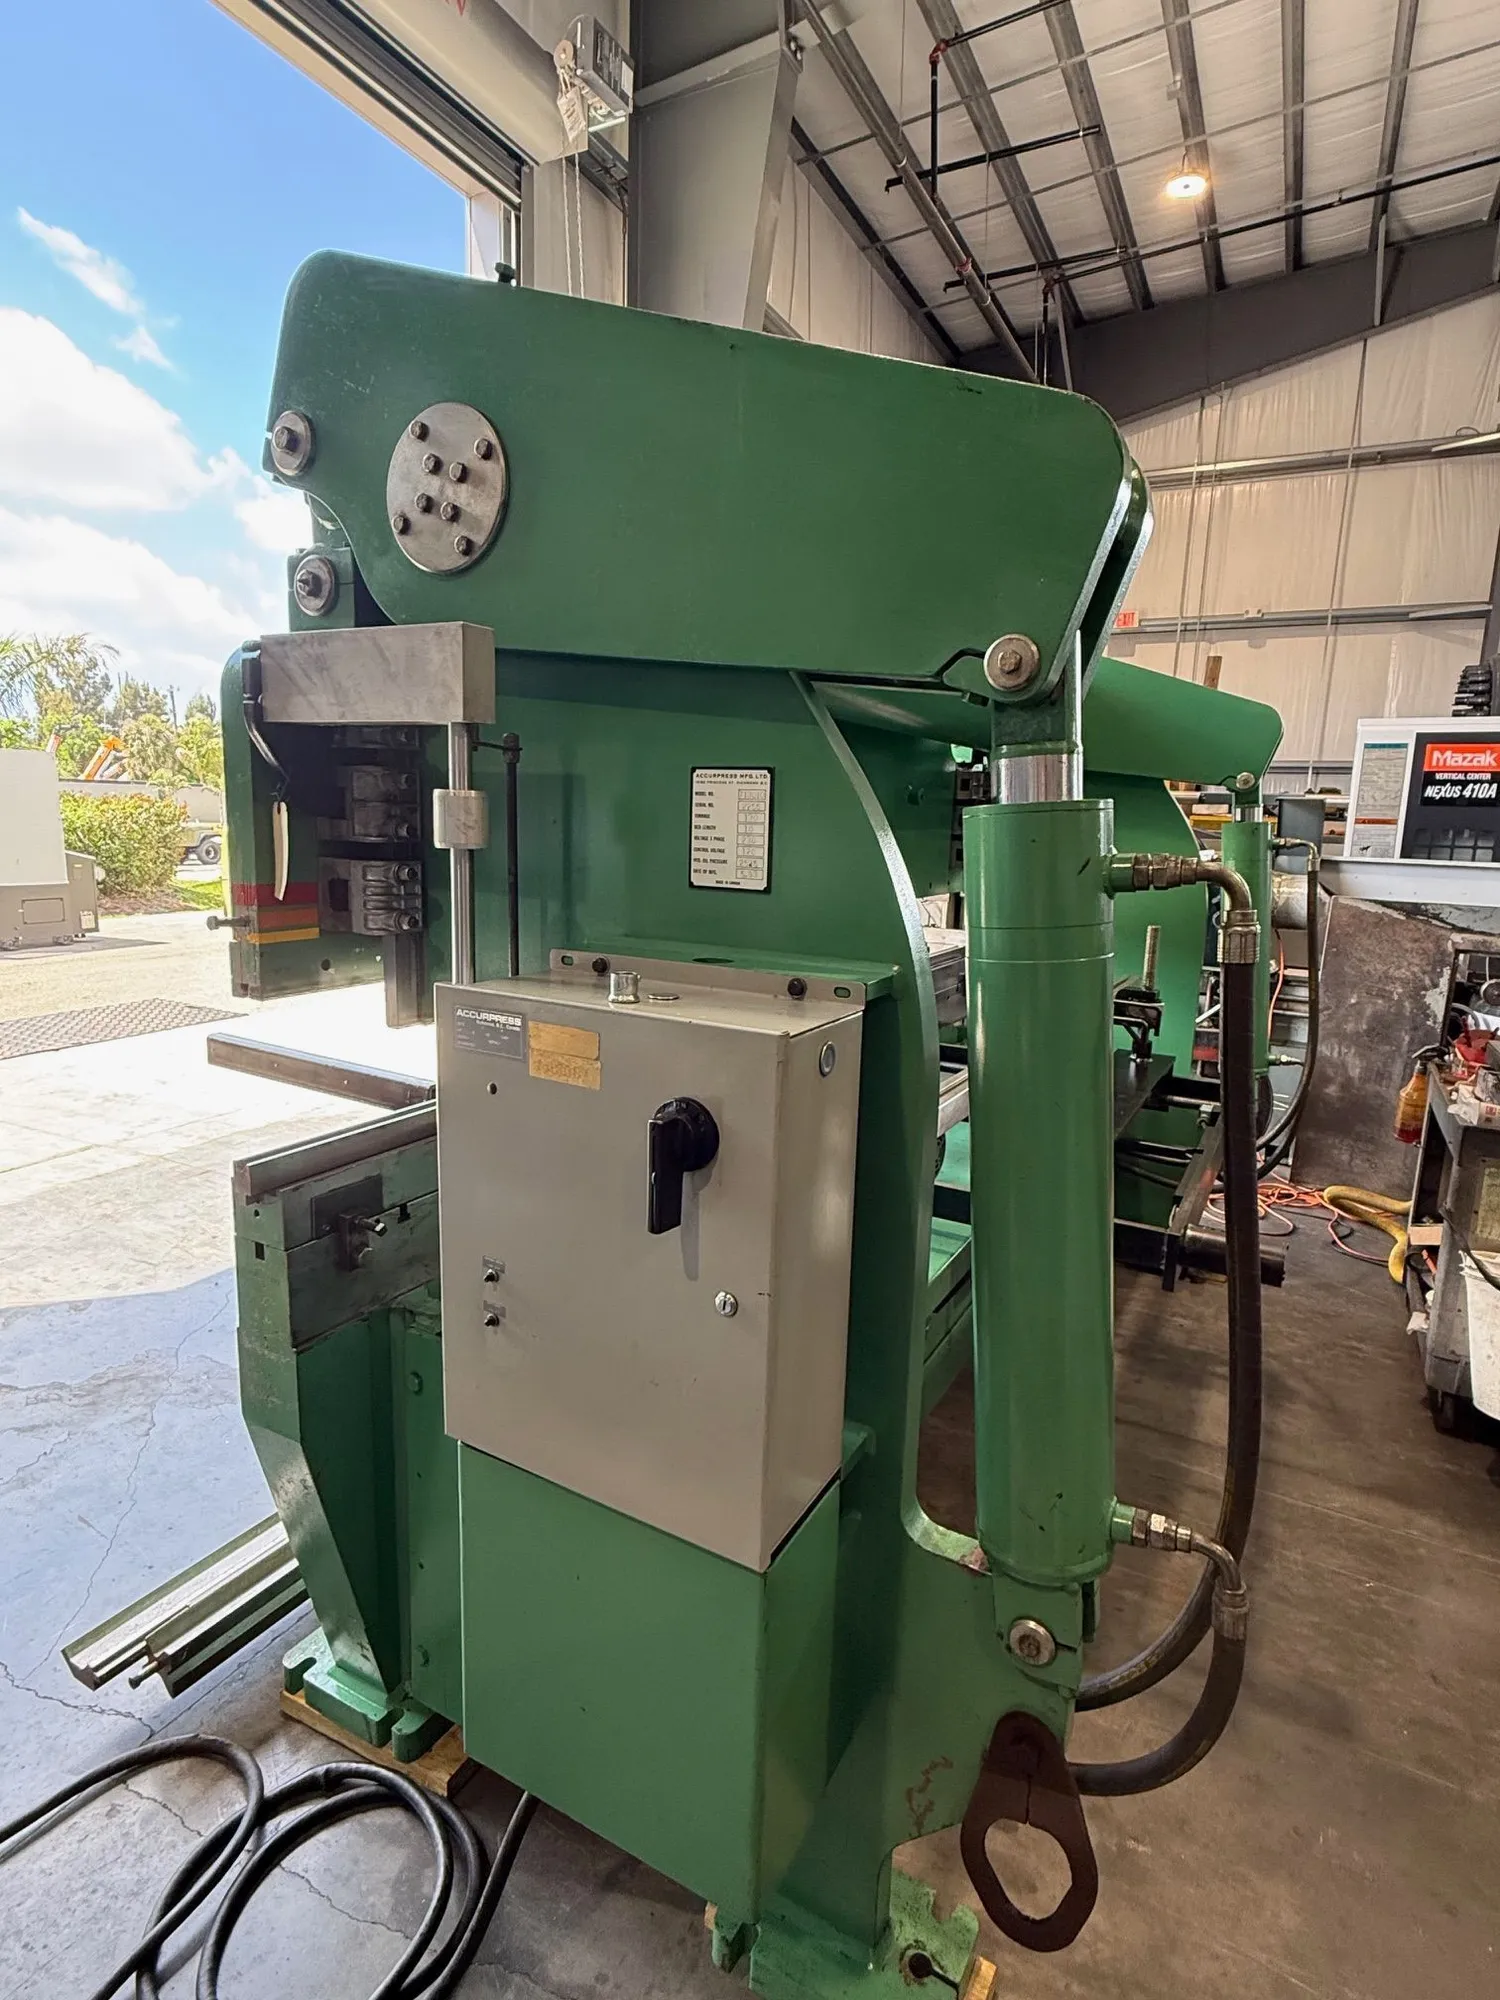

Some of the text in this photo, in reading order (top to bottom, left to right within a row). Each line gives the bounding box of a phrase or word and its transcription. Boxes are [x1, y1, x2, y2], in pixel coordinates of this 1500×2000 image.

[1432, 750, 1498, 767] Mazak
[1435, 772, 1492, 780] VERTICAL CENTER
[1424, 782, 1498, 800] NEXUS 410A
[456, 1008, 522, 1027] ACCURPRESS
